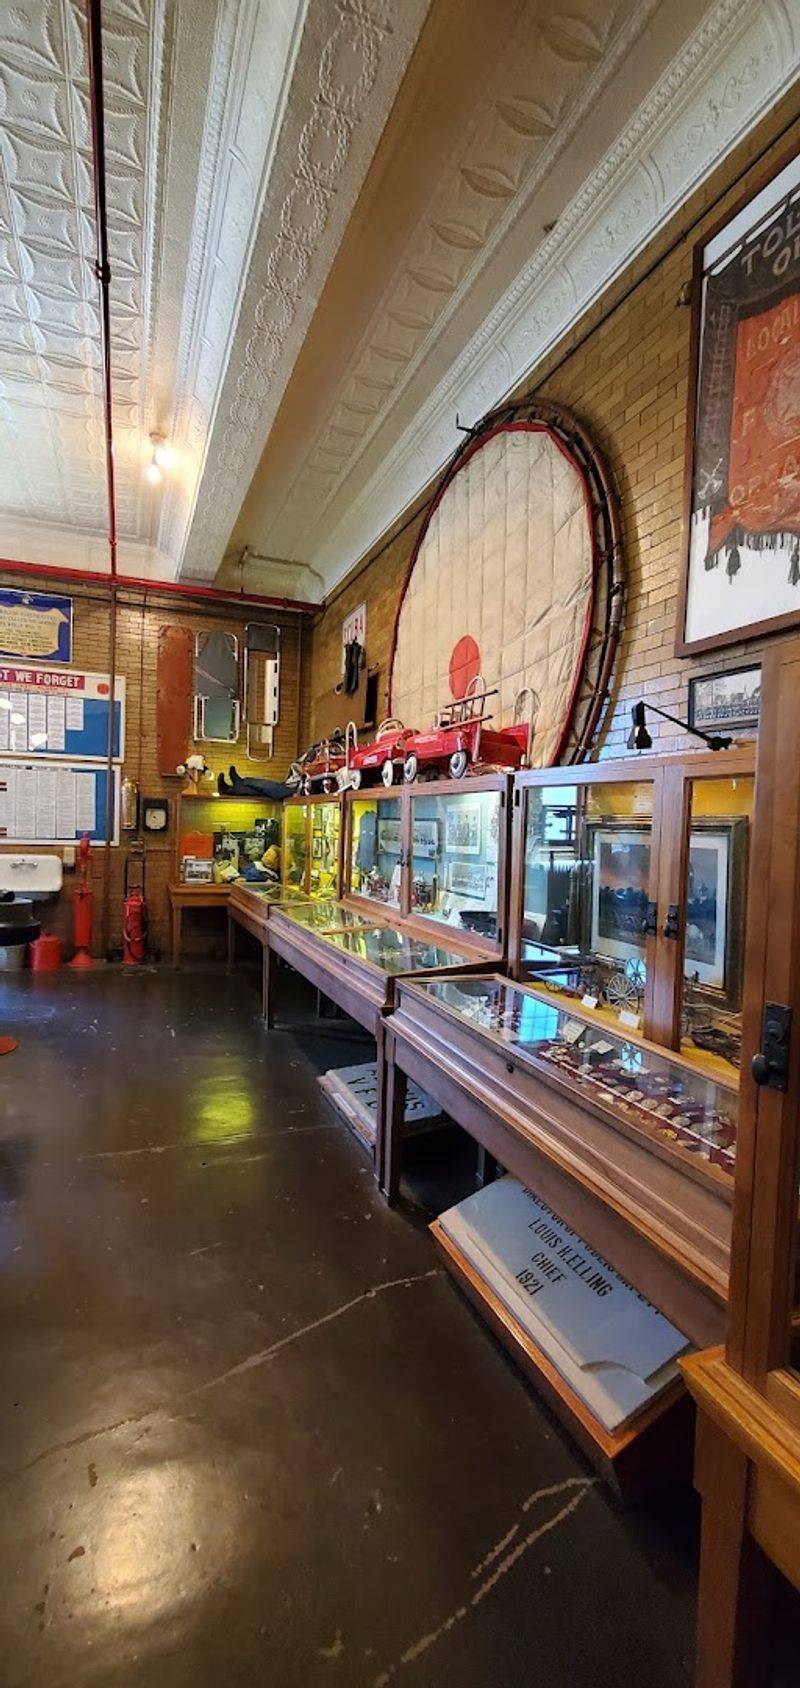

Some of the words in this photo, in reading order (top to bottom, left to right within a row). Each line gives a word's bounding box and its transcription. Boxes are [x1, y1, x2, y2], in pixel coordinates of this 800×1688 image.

[15, 670, 33, 683] WE
[36, 672, 80, 687] FORGET
[527, 1218, 562, 1248] LOUIS
[531, 1251, 568, 1283] CHIEF
[515, 1268, 545, 1296] 1921
